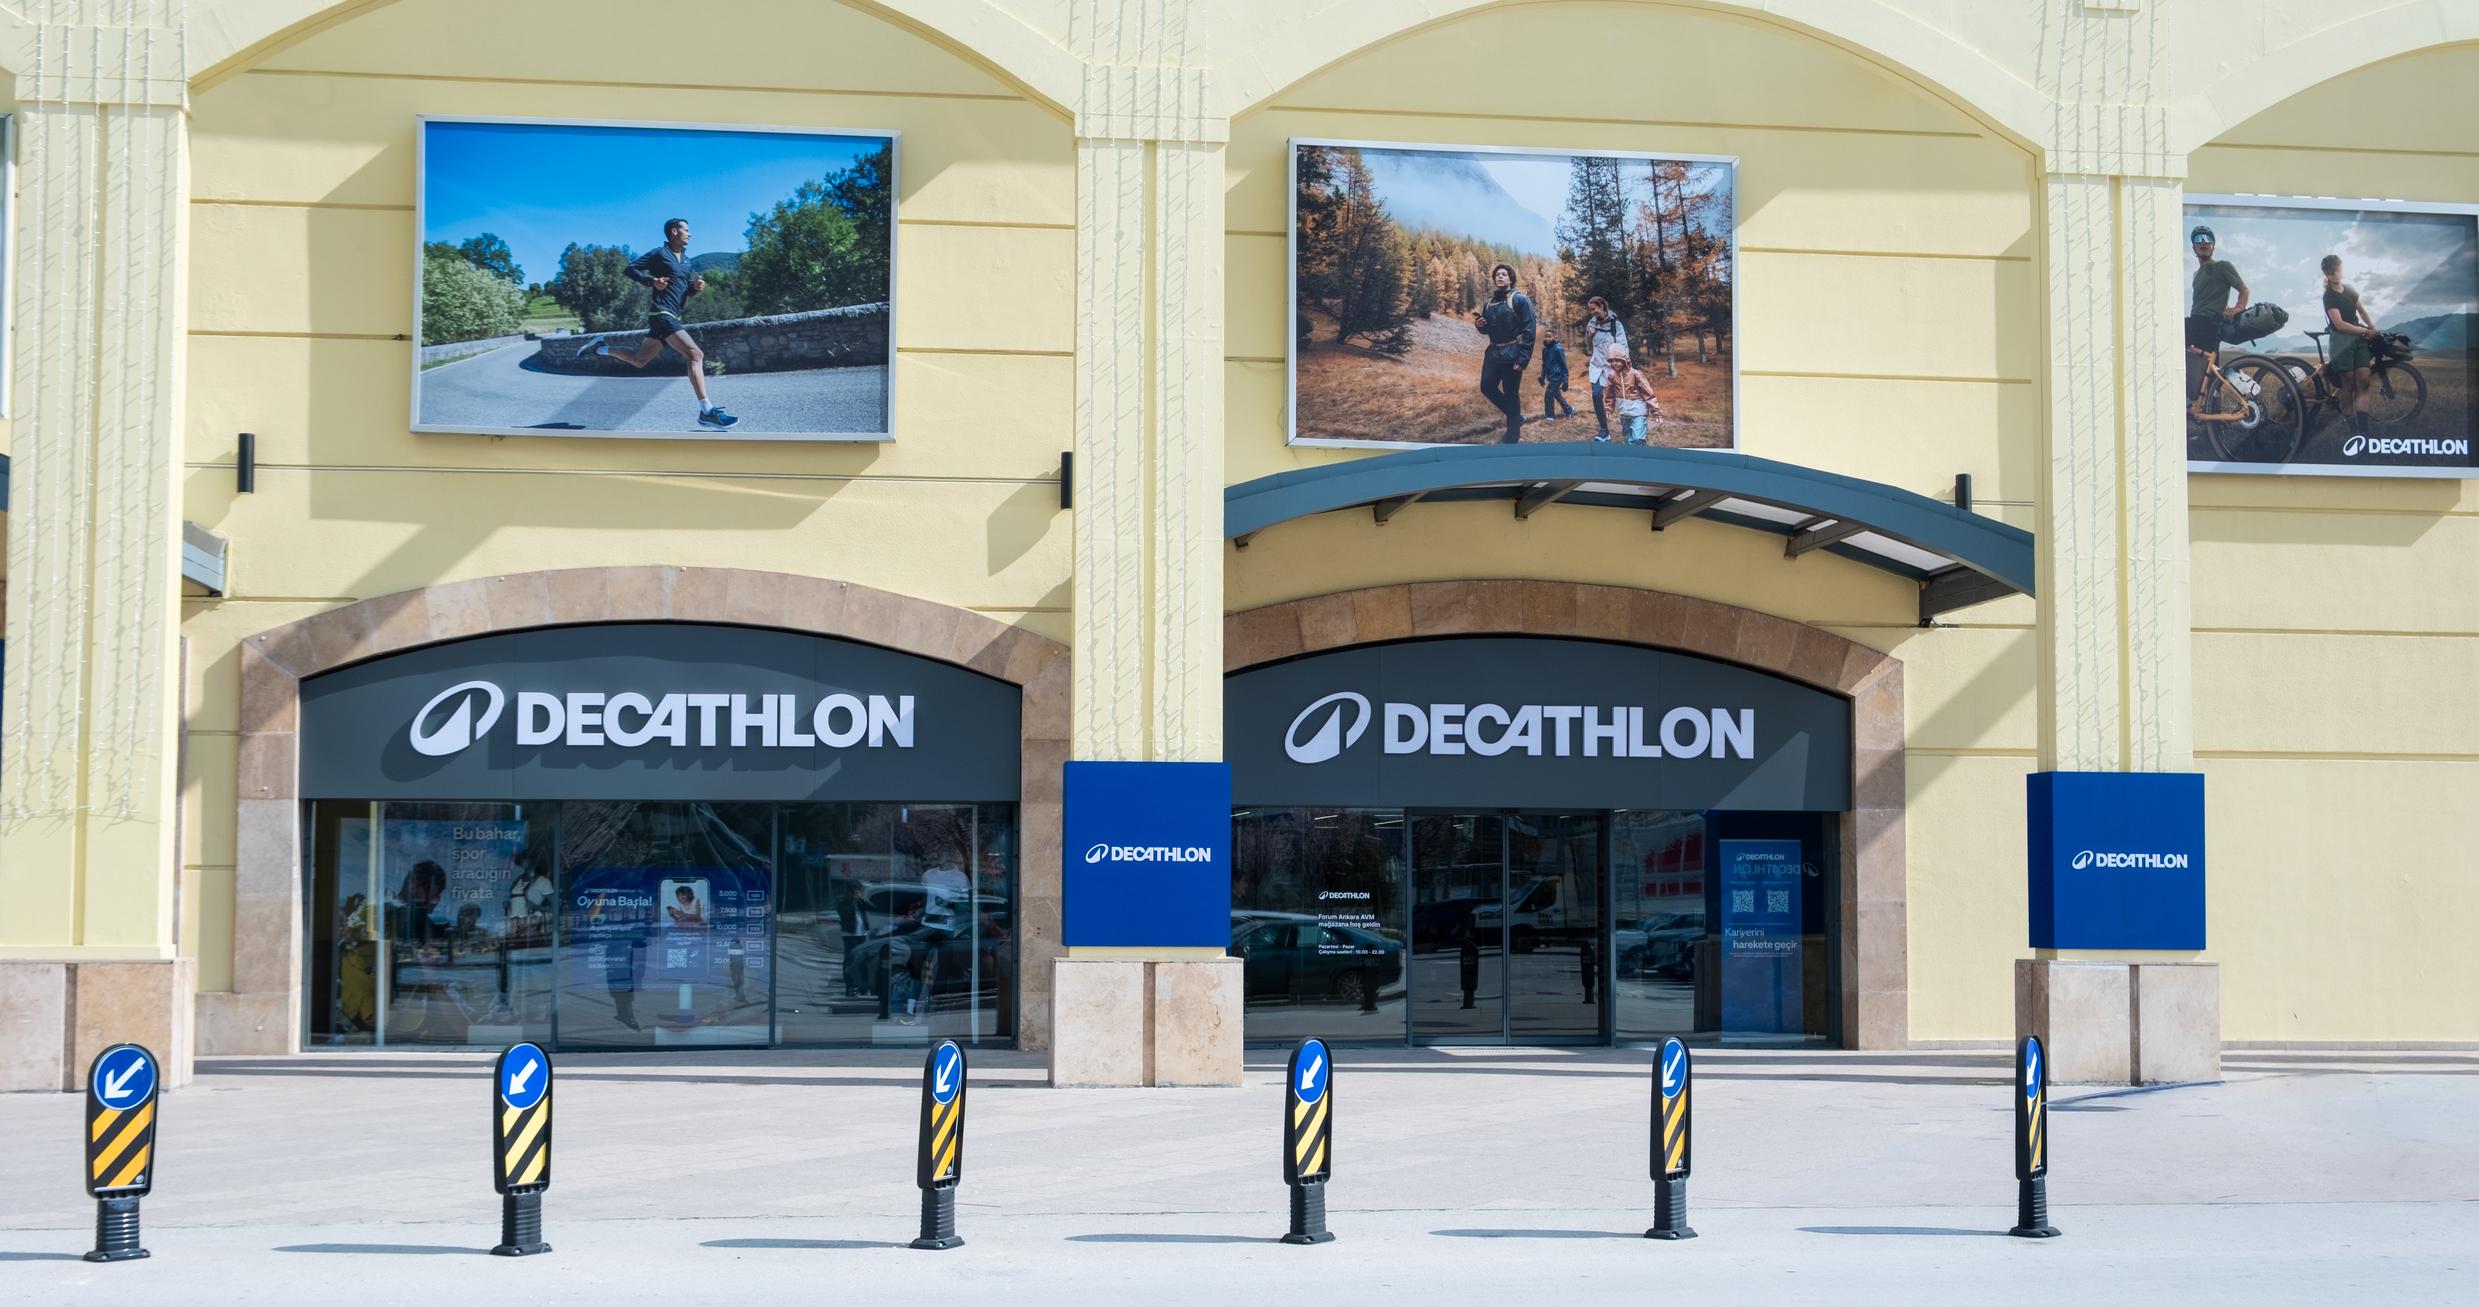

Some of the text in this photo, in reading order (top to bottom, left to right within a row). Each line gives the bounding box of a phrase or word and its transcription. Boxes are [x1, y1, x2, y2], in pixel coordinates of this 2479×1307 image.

[2369, 438, 2468, 454] DECATHLON
[516, 691, 914, 748] DECATHLON
[1384, 702, 1755, 759] DECATHLON
[453, 827, 521, 842] Bu bahar,
[452, 849, 487, 862] spor
[1111, 846, 1211, 863] DECATHLON
[2096, 853, 2188, 869] DECATHLON
[452, 866, 512, 882] aradığın
[451, 886, 493, 901] fiyata
[577, 895, 652, 909] Oyuna Başla!
[1318, 921, 1349, 929] mağazana
[1725, 928, 1765, 938] Kariyerini
[1733, 940, 1798, 951] harekete geçir
